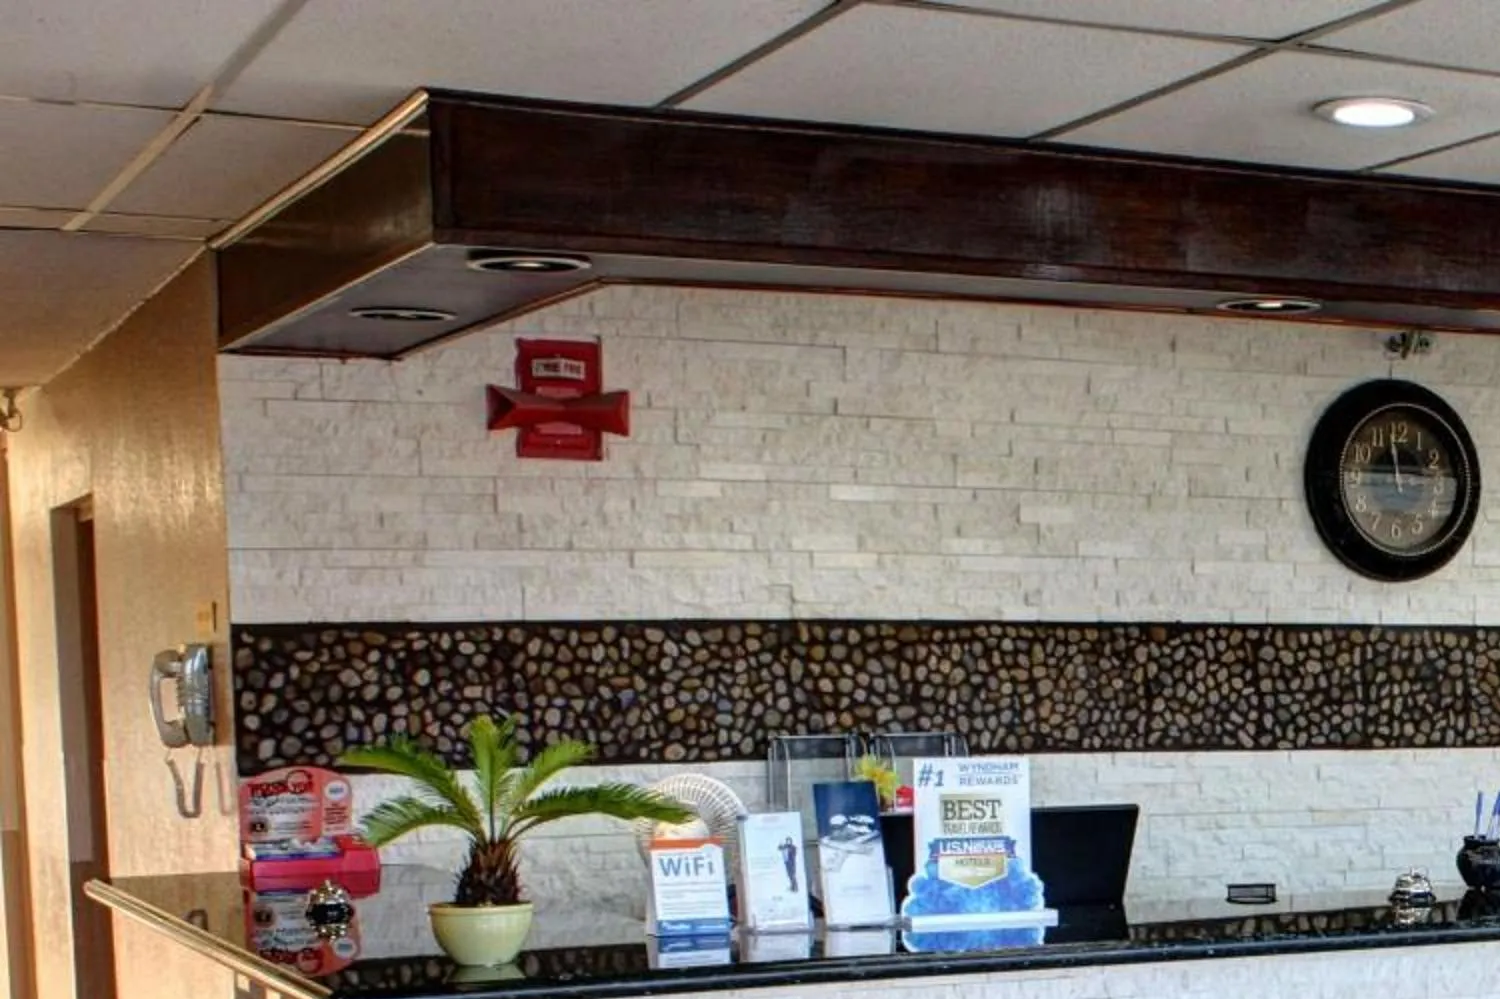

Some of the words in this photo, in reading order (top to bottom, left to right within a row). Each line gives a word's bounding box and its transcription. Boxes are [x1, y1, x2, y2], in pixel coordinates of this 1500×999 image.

[1371, 427, 1384, 448] 11
[1388, 421, 1408, 443] 12
[1353, 444, 1371, 463] 10
[1428, 448, 1440, 469] 2
[1354, 495, 1367, 513] 8
[1371, 512, 1381, 531] 7
[1390, 520, 1401, 539] 6
[1411, 514, 1423, 535] 5
[918, 763, 945, 788] #1
[957, 763, 1019, 772] WYNDHAM
[942, 799, 1002, 820] BEST
[658, 854, 715, 877] WiFi
